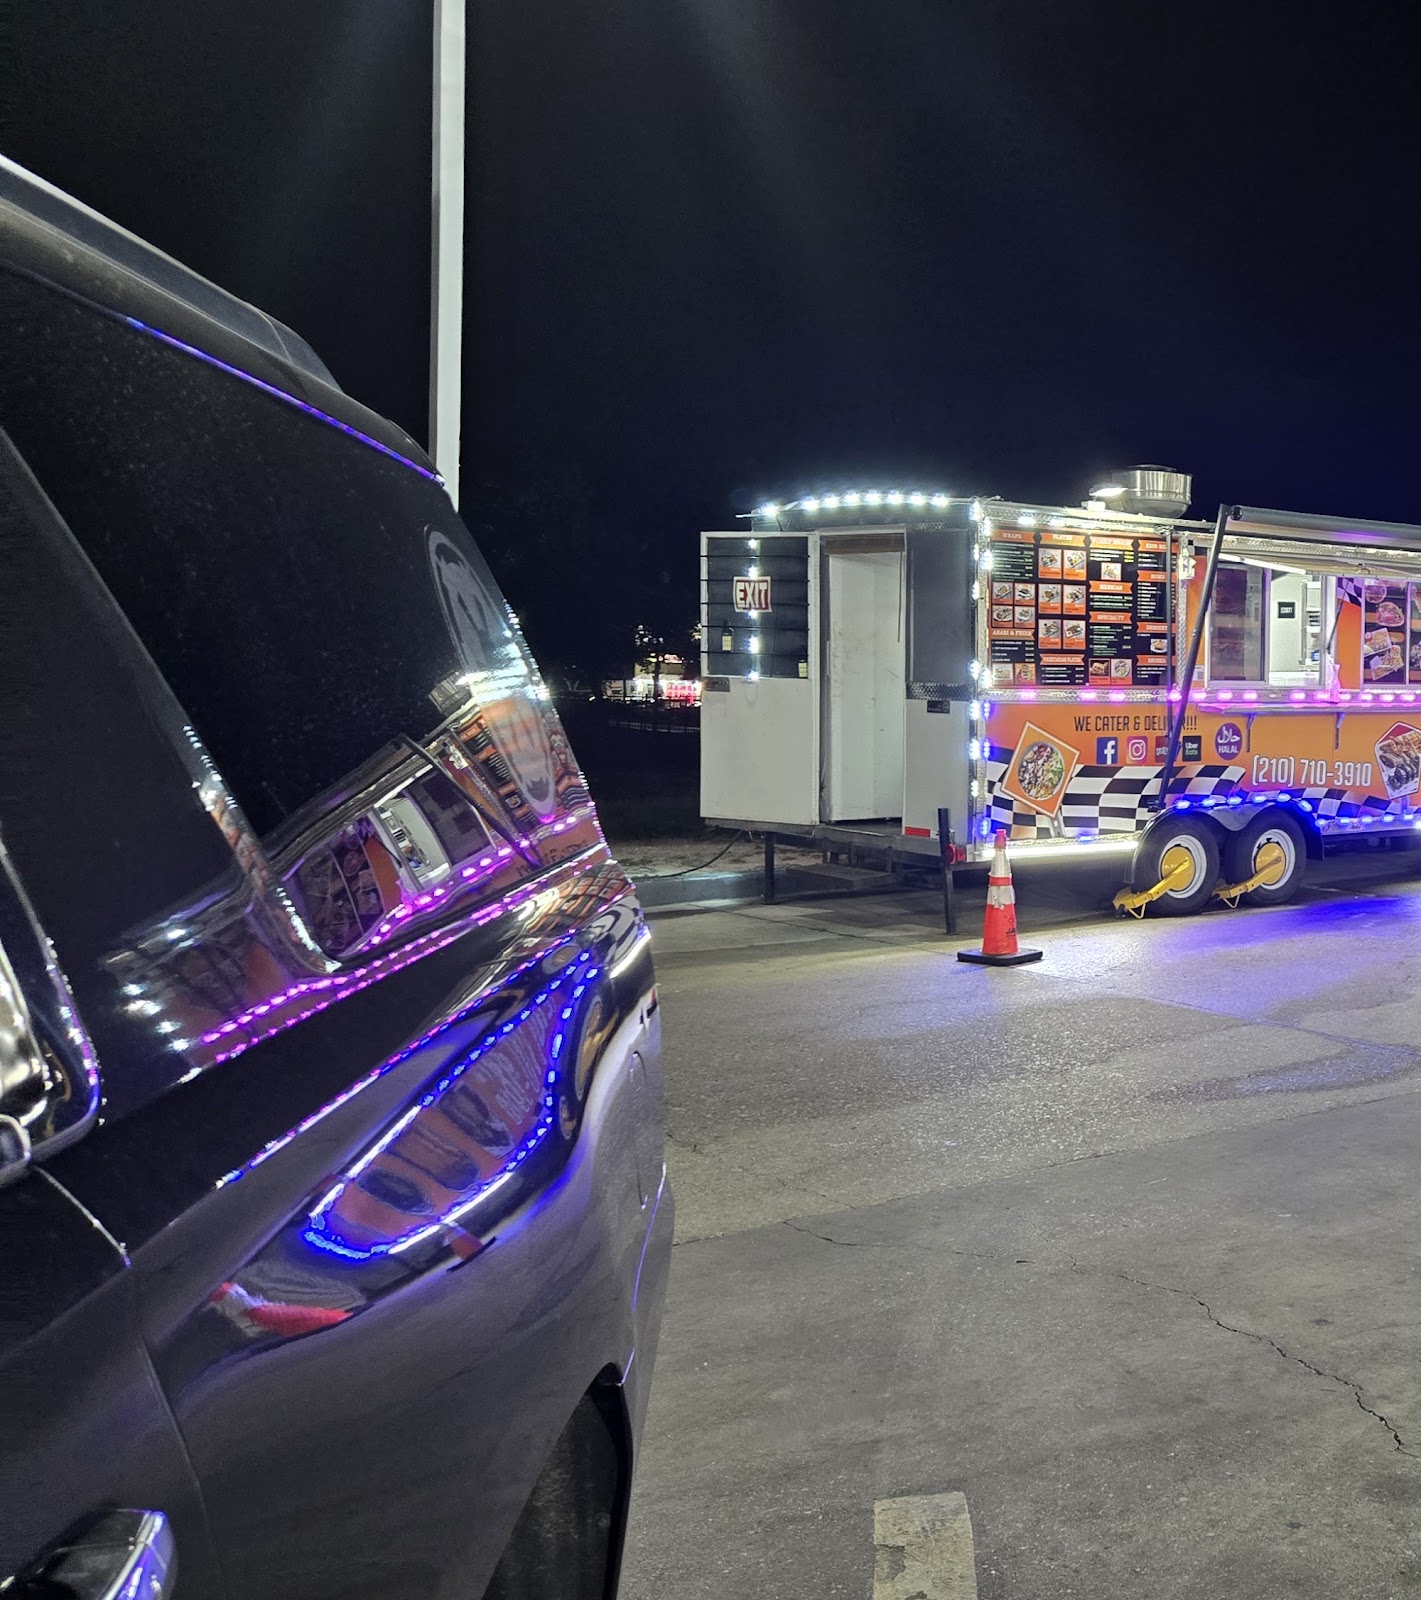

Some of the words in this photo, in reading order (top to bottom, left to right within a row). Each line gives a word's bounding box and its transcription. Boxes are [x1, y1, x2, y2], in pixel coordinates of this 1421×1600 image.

[736, 581, 767, 609] EXIT
[1074, 716, 1091, 732] WE
[1095, 715, 1130, 731] CATER
[1133, 716, 1141, 731] &
[1218, 745, 1239, 753] HALAL
[1252, 755, 1295, 787] (210)
[1300, 759, 1372, 787] 710-3910
